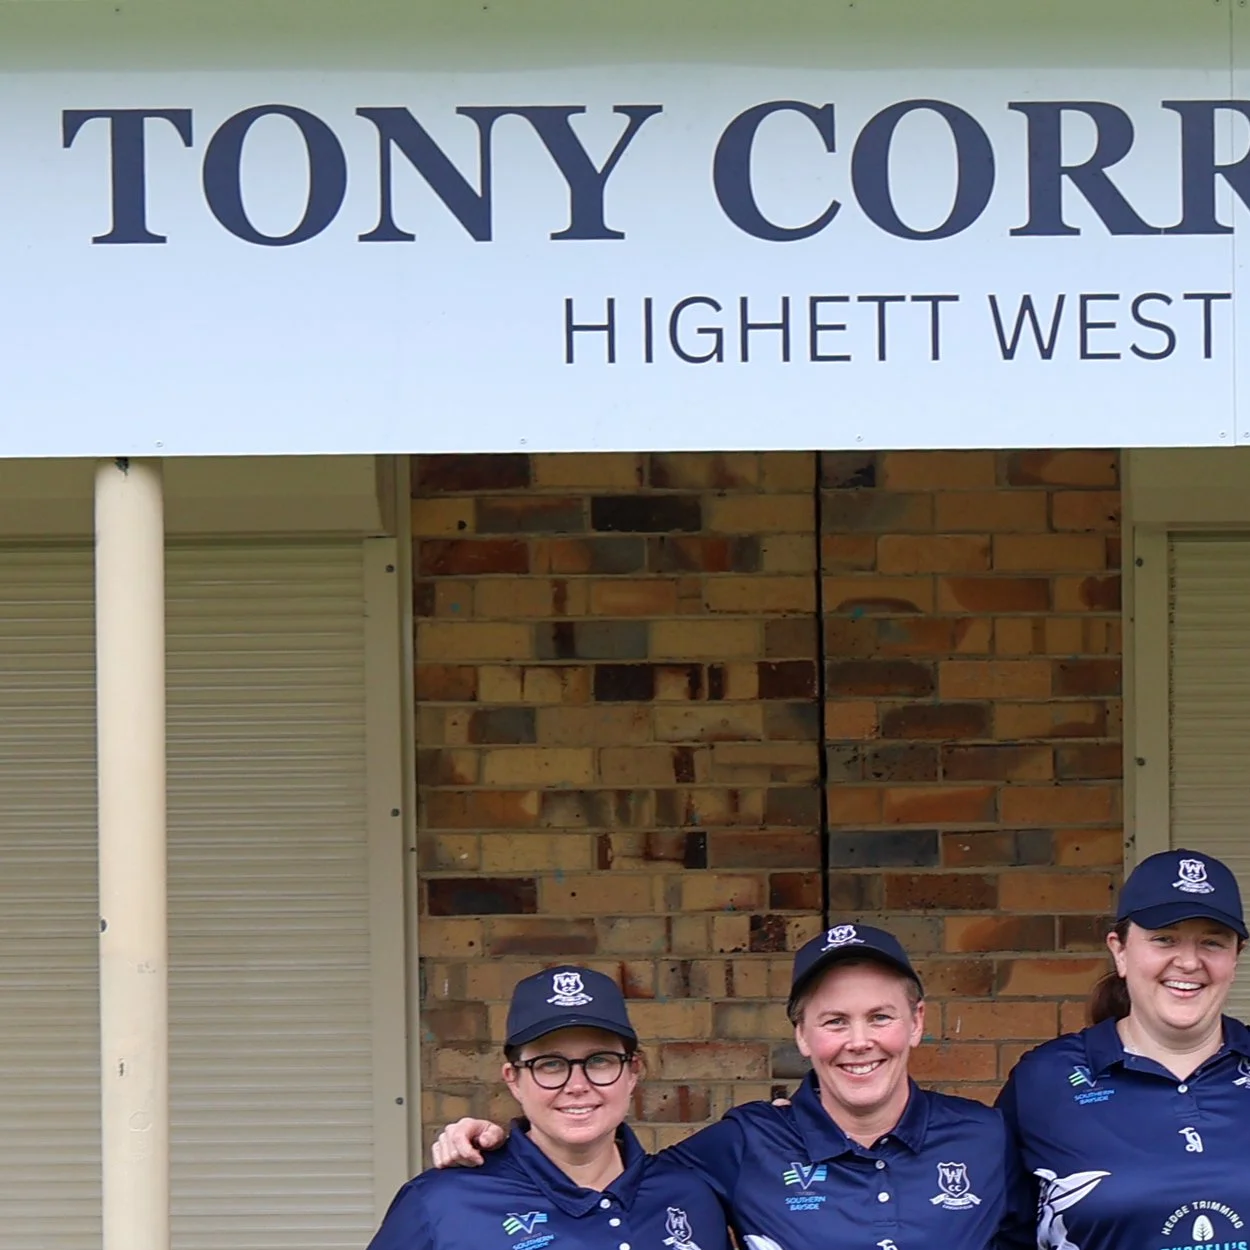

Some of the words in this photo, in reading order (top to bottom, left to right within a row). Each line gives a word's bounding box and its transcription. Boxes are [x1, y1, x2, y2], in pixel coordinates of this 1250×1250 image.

[61, 103, 664, 247] TONY
[563, 293, 961, 366] HIGHETT
[987, 290, 1233, 363] WEST
[1160, 1205, 1190, 1236] HEDGE
[1192, 1200, 1244, 1230] TRIMMING
